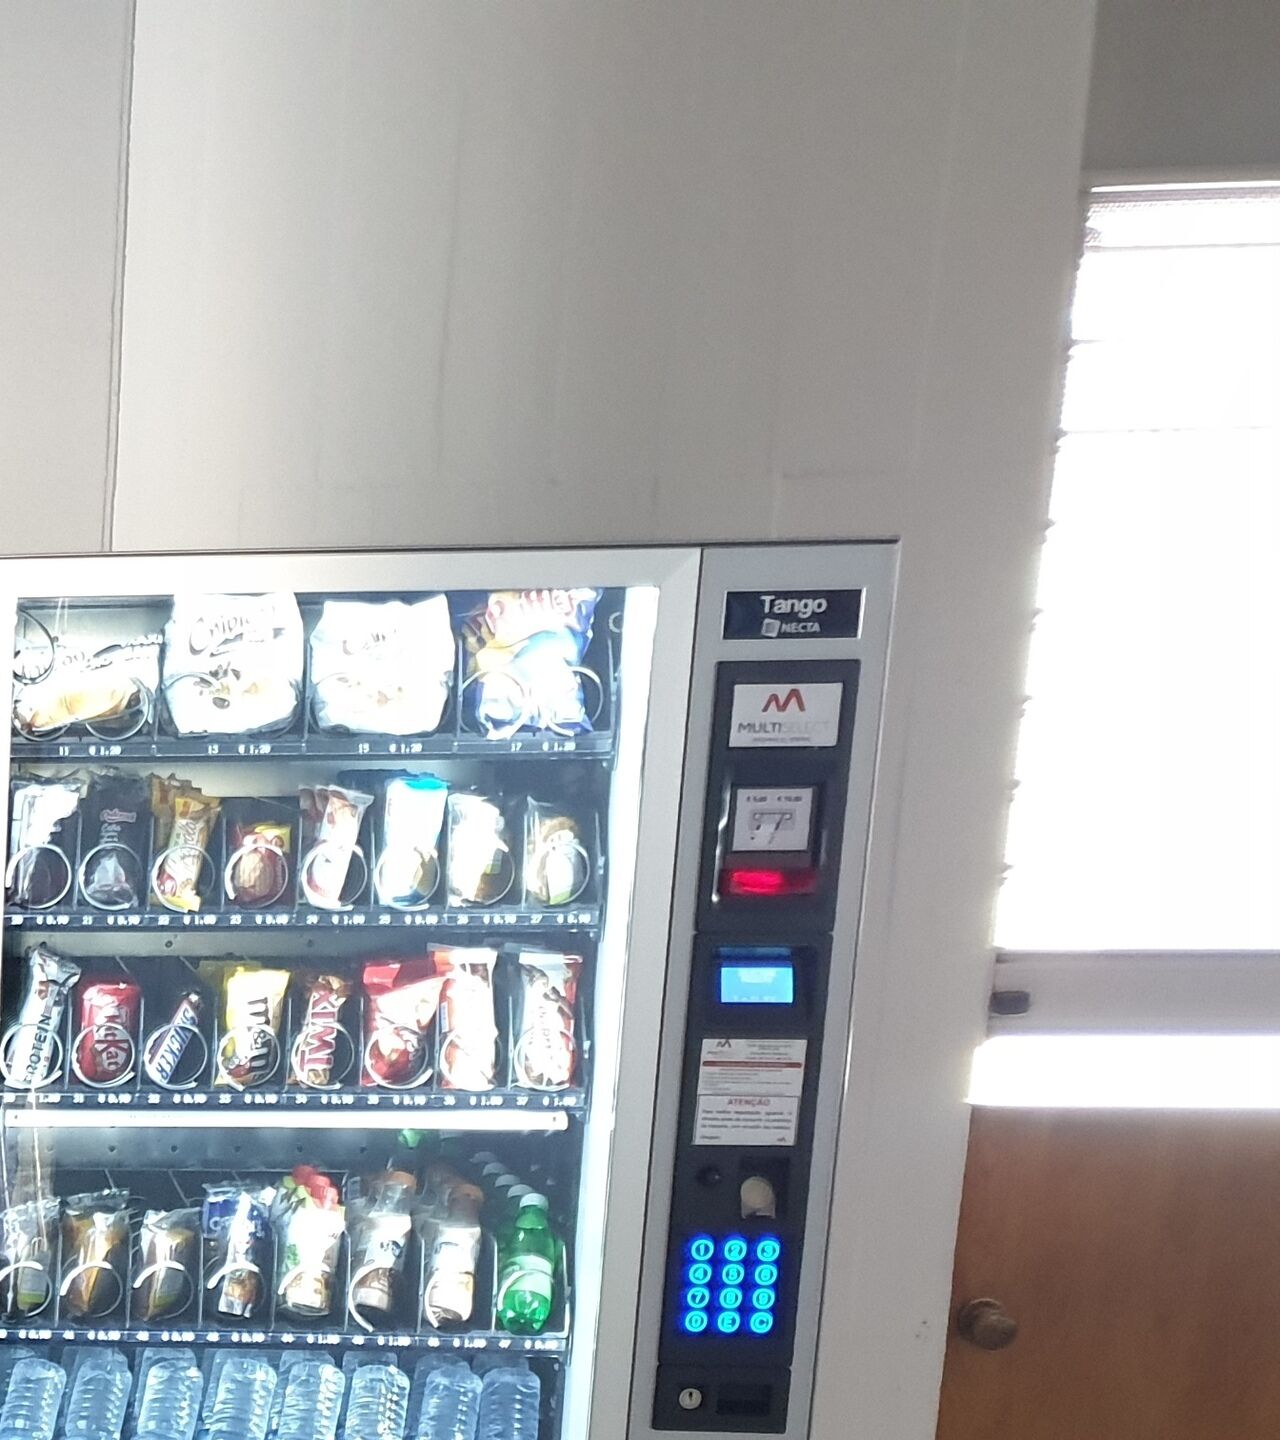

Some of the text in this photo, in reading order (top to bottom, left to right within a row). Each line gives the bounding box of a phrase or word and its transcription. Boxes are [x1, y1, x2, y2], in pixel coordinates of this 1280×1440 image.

[760, 595, 828, 618] Tango
[781, 622, 821, 633] NECTA
[300, 991, 339, 1072] TWIX
[728, 1098, 771, 1107] ATENÇÃO
